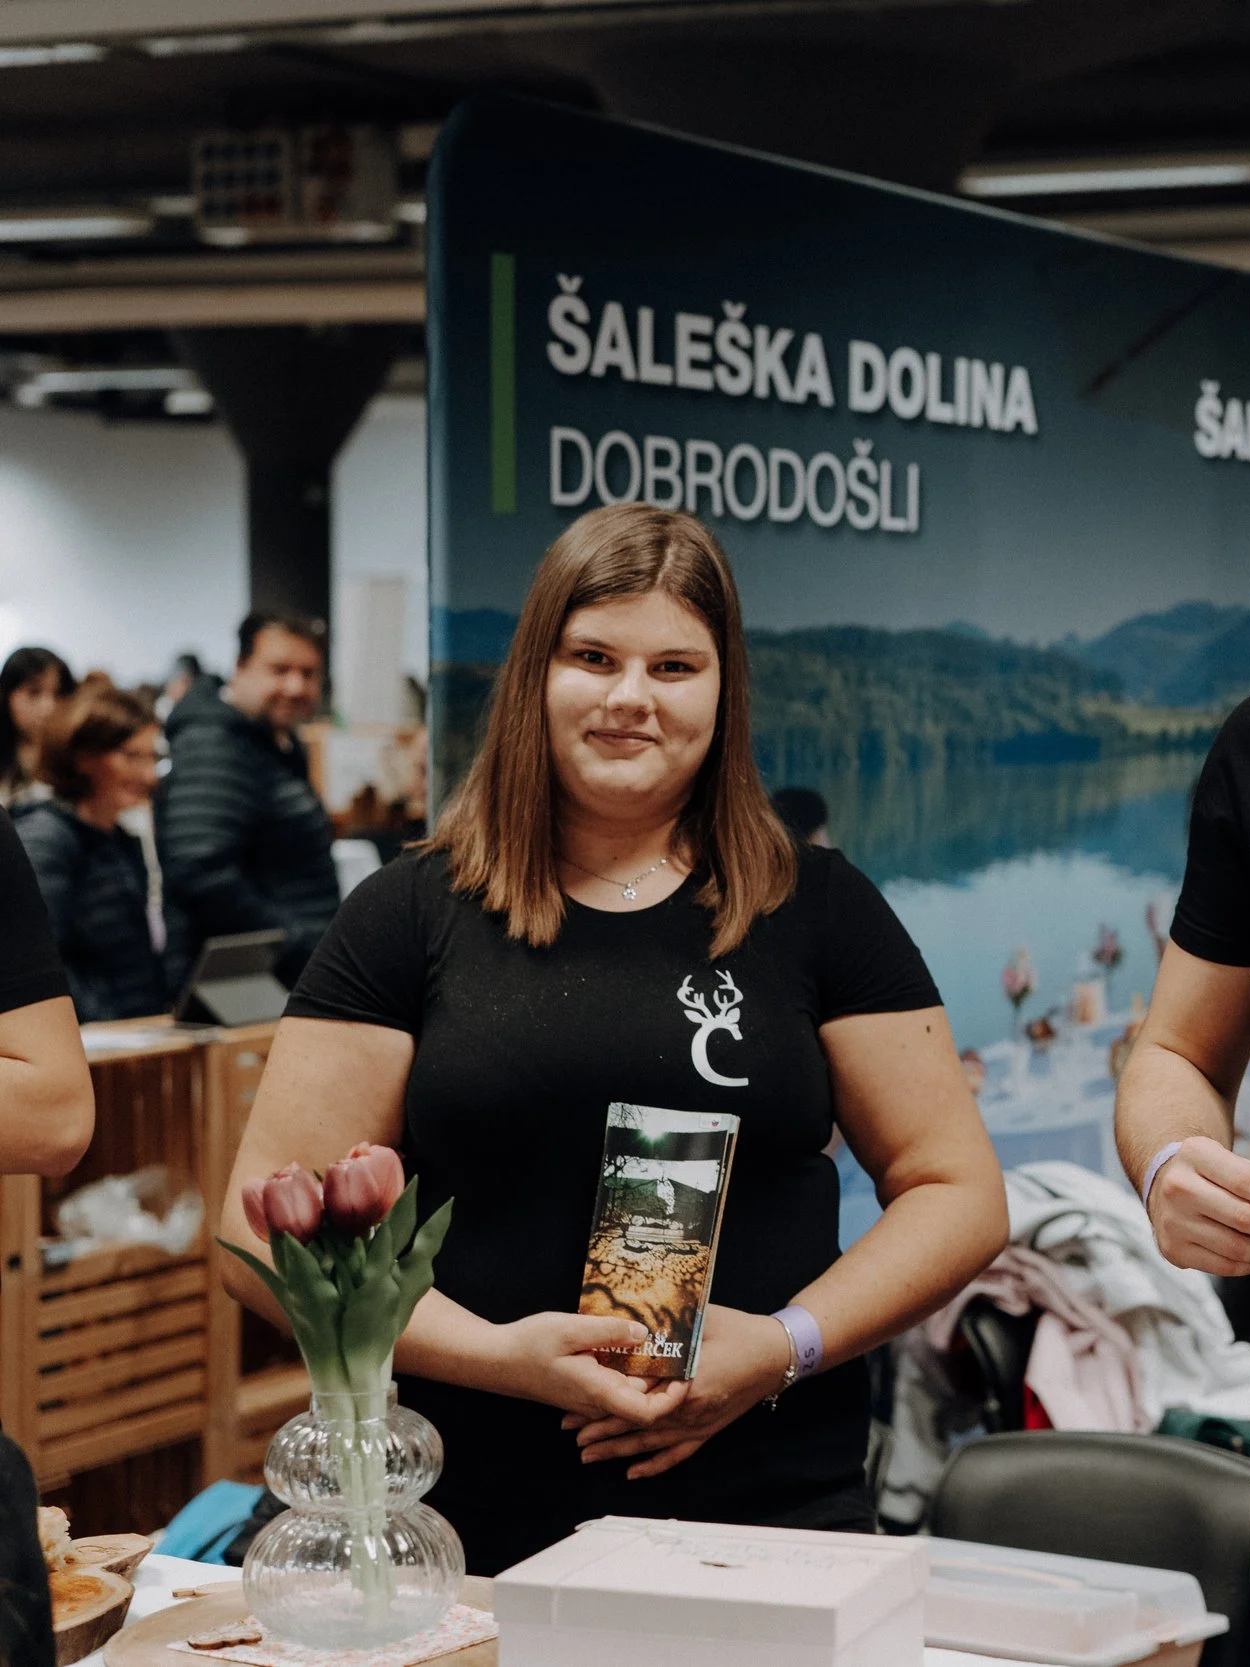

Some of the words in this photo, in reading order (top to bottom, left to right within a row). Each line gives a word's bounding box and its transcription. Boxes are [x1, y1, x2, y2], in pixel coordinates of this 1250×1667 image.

[547, 273, 835, 408] ŠALEŠKA
[848, 339, 1038, 435] DOLINA
[550, 426, 920, 533] DOBRODOŠLI
